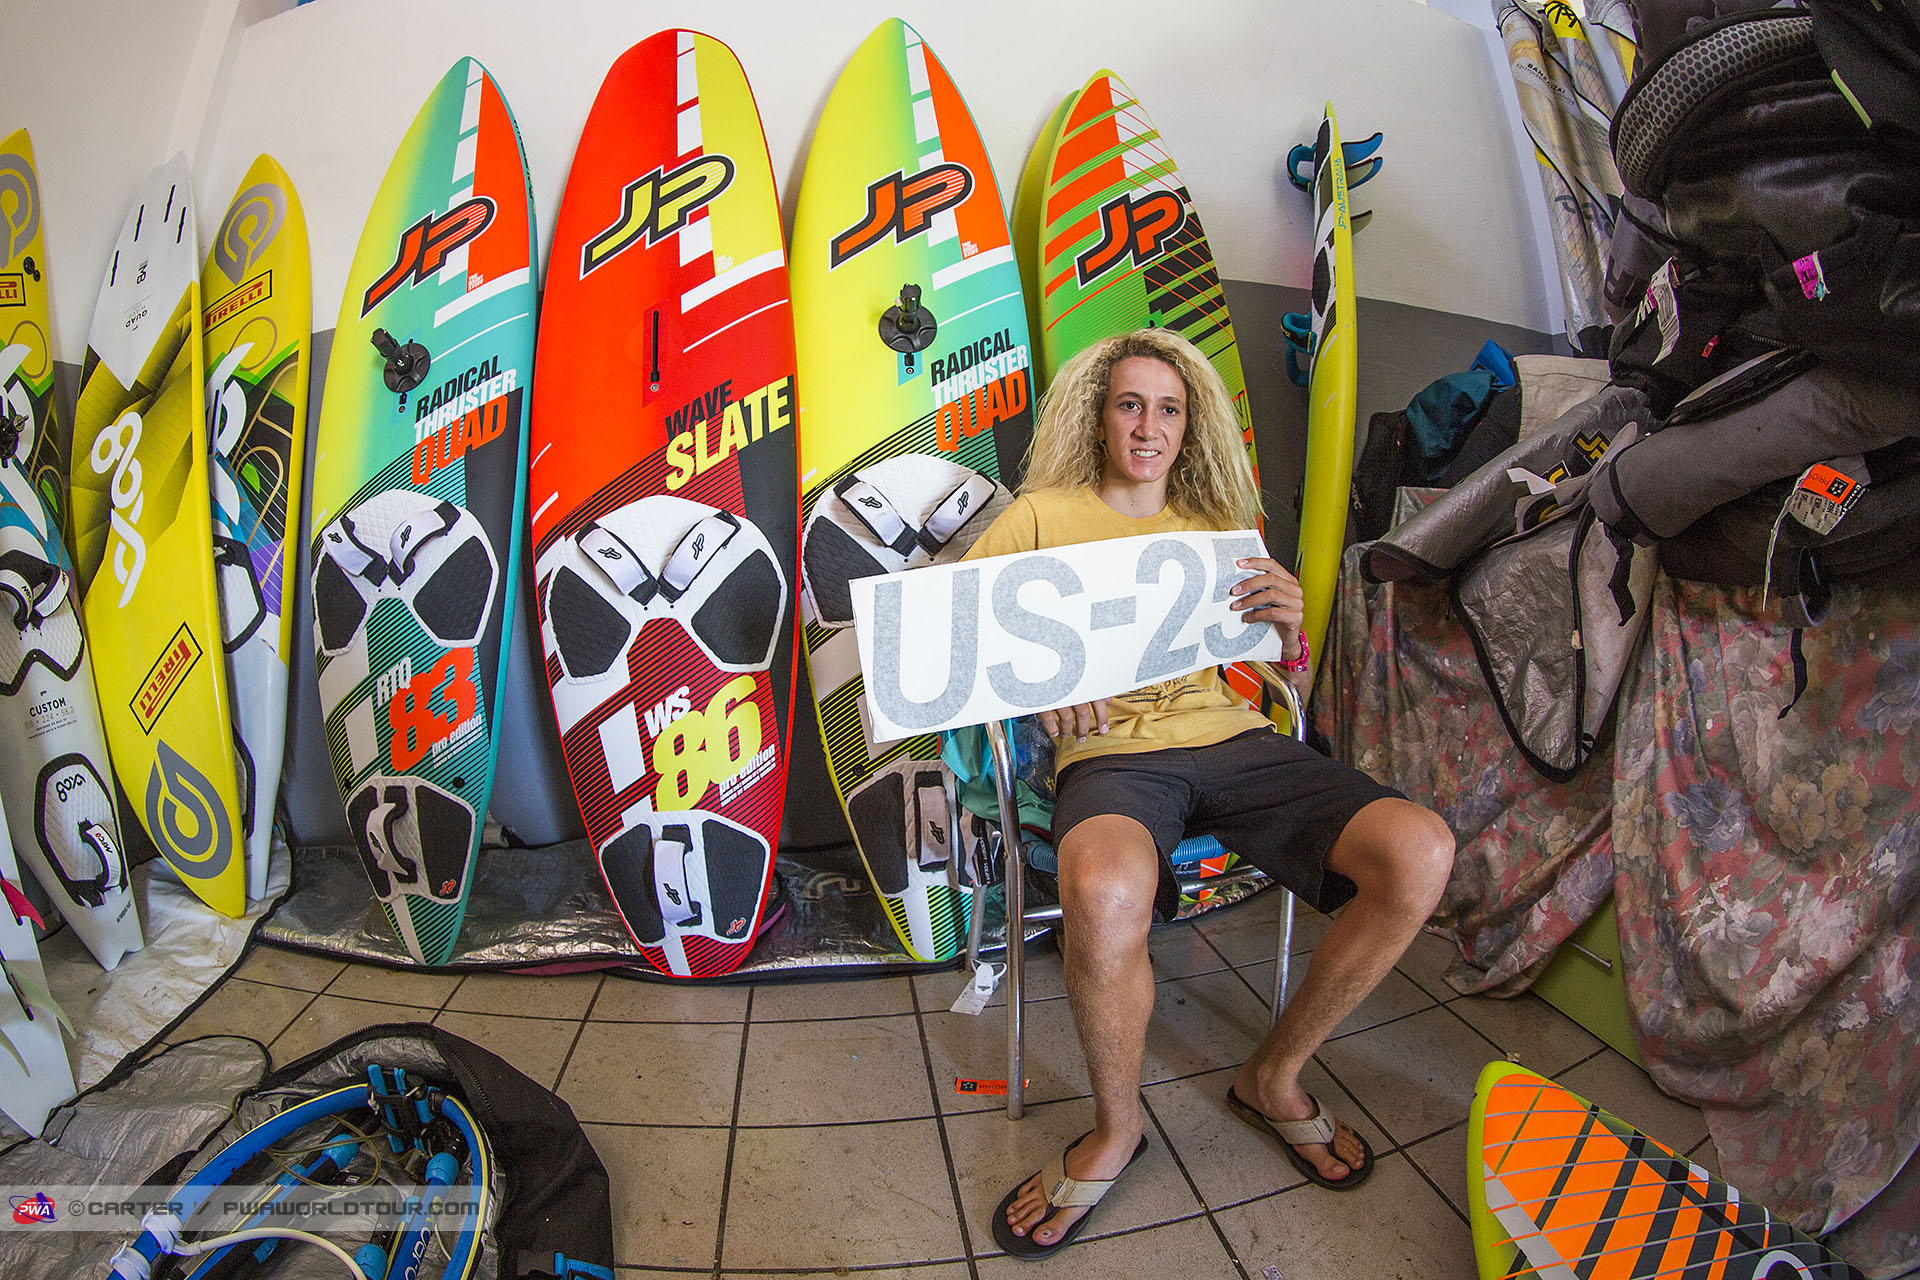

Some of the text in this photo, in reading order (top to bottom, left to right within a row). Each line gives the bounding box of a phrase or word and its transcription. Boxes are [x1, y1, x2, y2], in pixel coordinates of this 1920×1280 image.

[581, 155, 735, 280] JP
[830, 163, 974, 272] JP
[1075, 190, 1186, 289] JP
[360, 197, 496, 321] JP
[205, 281, 264, 329] PIRELLI
[416, 355, 502, 424] RADICAL
[930, 328, 1015, 387] RADICAL
[931, 344, 1029, 410] THRUSTER
[411, 395, 509, 486] QUAD
[414, 368, 517, 446] THRUSTER
[665, 378, 733, 442] WAVE
[665, 376, 791, 491] SLATE
[935, 370, 1027, 454] QUAD
[873, 537, 1273, 730] US-25
[29, 697, 67, 718] CUSTOM
[139, 639, 192, 719] PIRELLI
[376, 656, 412, 708] RTQ
[388, 646, 477, 772] 83
[643, 685, 692, 739] WS
[432, 736, 447, 758] pro
[449, 713, 482, 745] edition
[652, 675, 762, 813] 86
[719, 773, 737, 797] pro
[740, 743, 776, 780] edition
